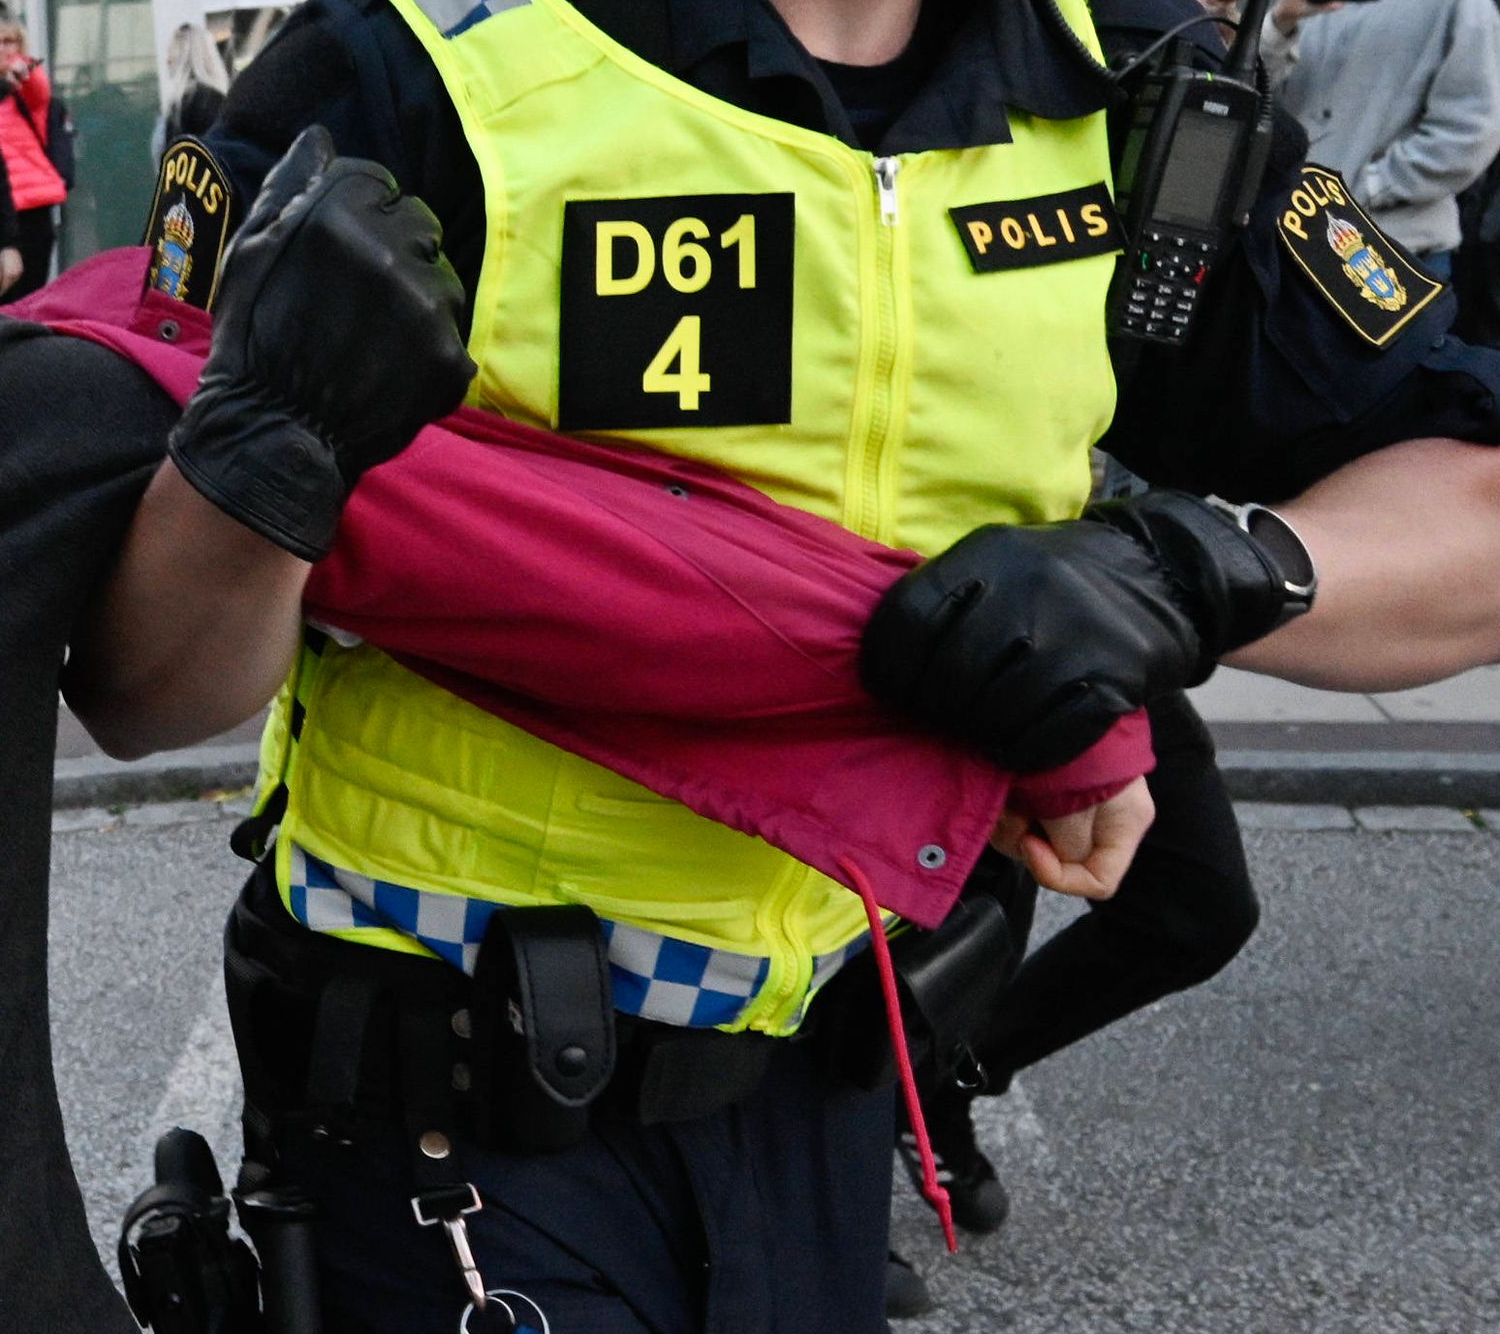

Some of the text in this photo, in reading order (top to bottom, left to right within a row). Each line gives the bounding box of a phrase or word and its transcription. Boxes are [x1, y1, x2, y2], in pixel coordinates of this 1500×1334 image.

[165, 152, 223, 215] POLIS
[1283, 176, 1346, 241] POLIS
[596, 214, 756, 296] D61
[967, 203, 1109, 255] POLIS
[643, 315, 711, 410] 4
